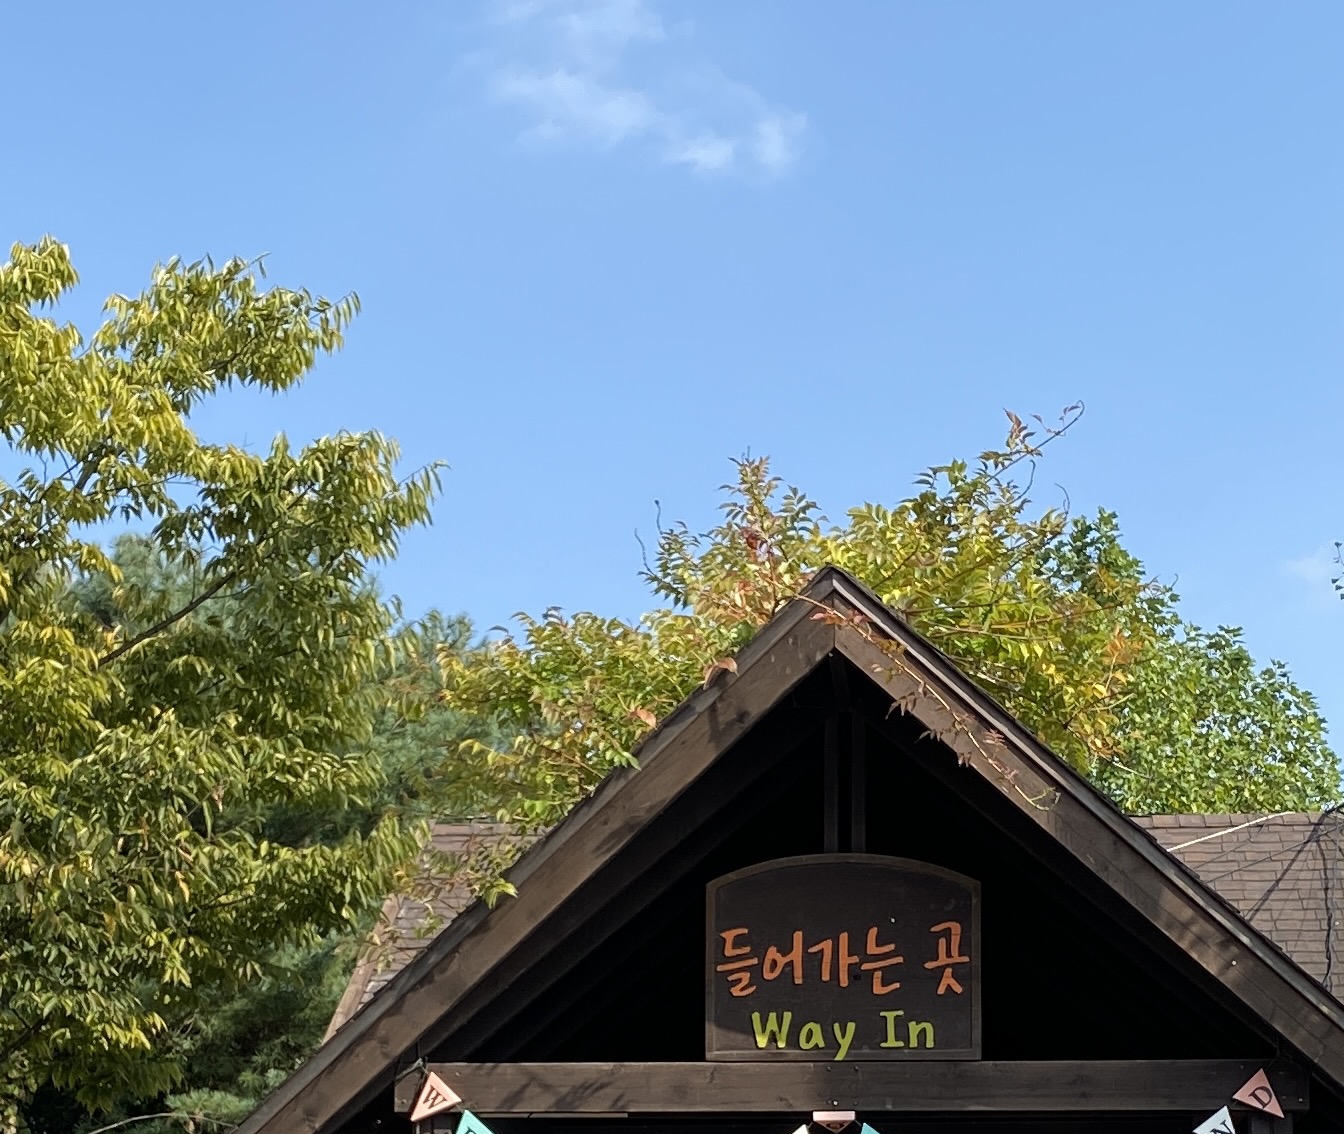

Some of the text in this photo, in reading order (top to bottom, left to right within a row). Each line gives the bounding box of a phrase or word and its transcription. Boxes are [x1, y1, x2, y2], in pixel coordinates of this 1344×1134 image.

[716, 920, 970, 997] 들어가는 곳
[751, 1009, 936, 1061] Way In
